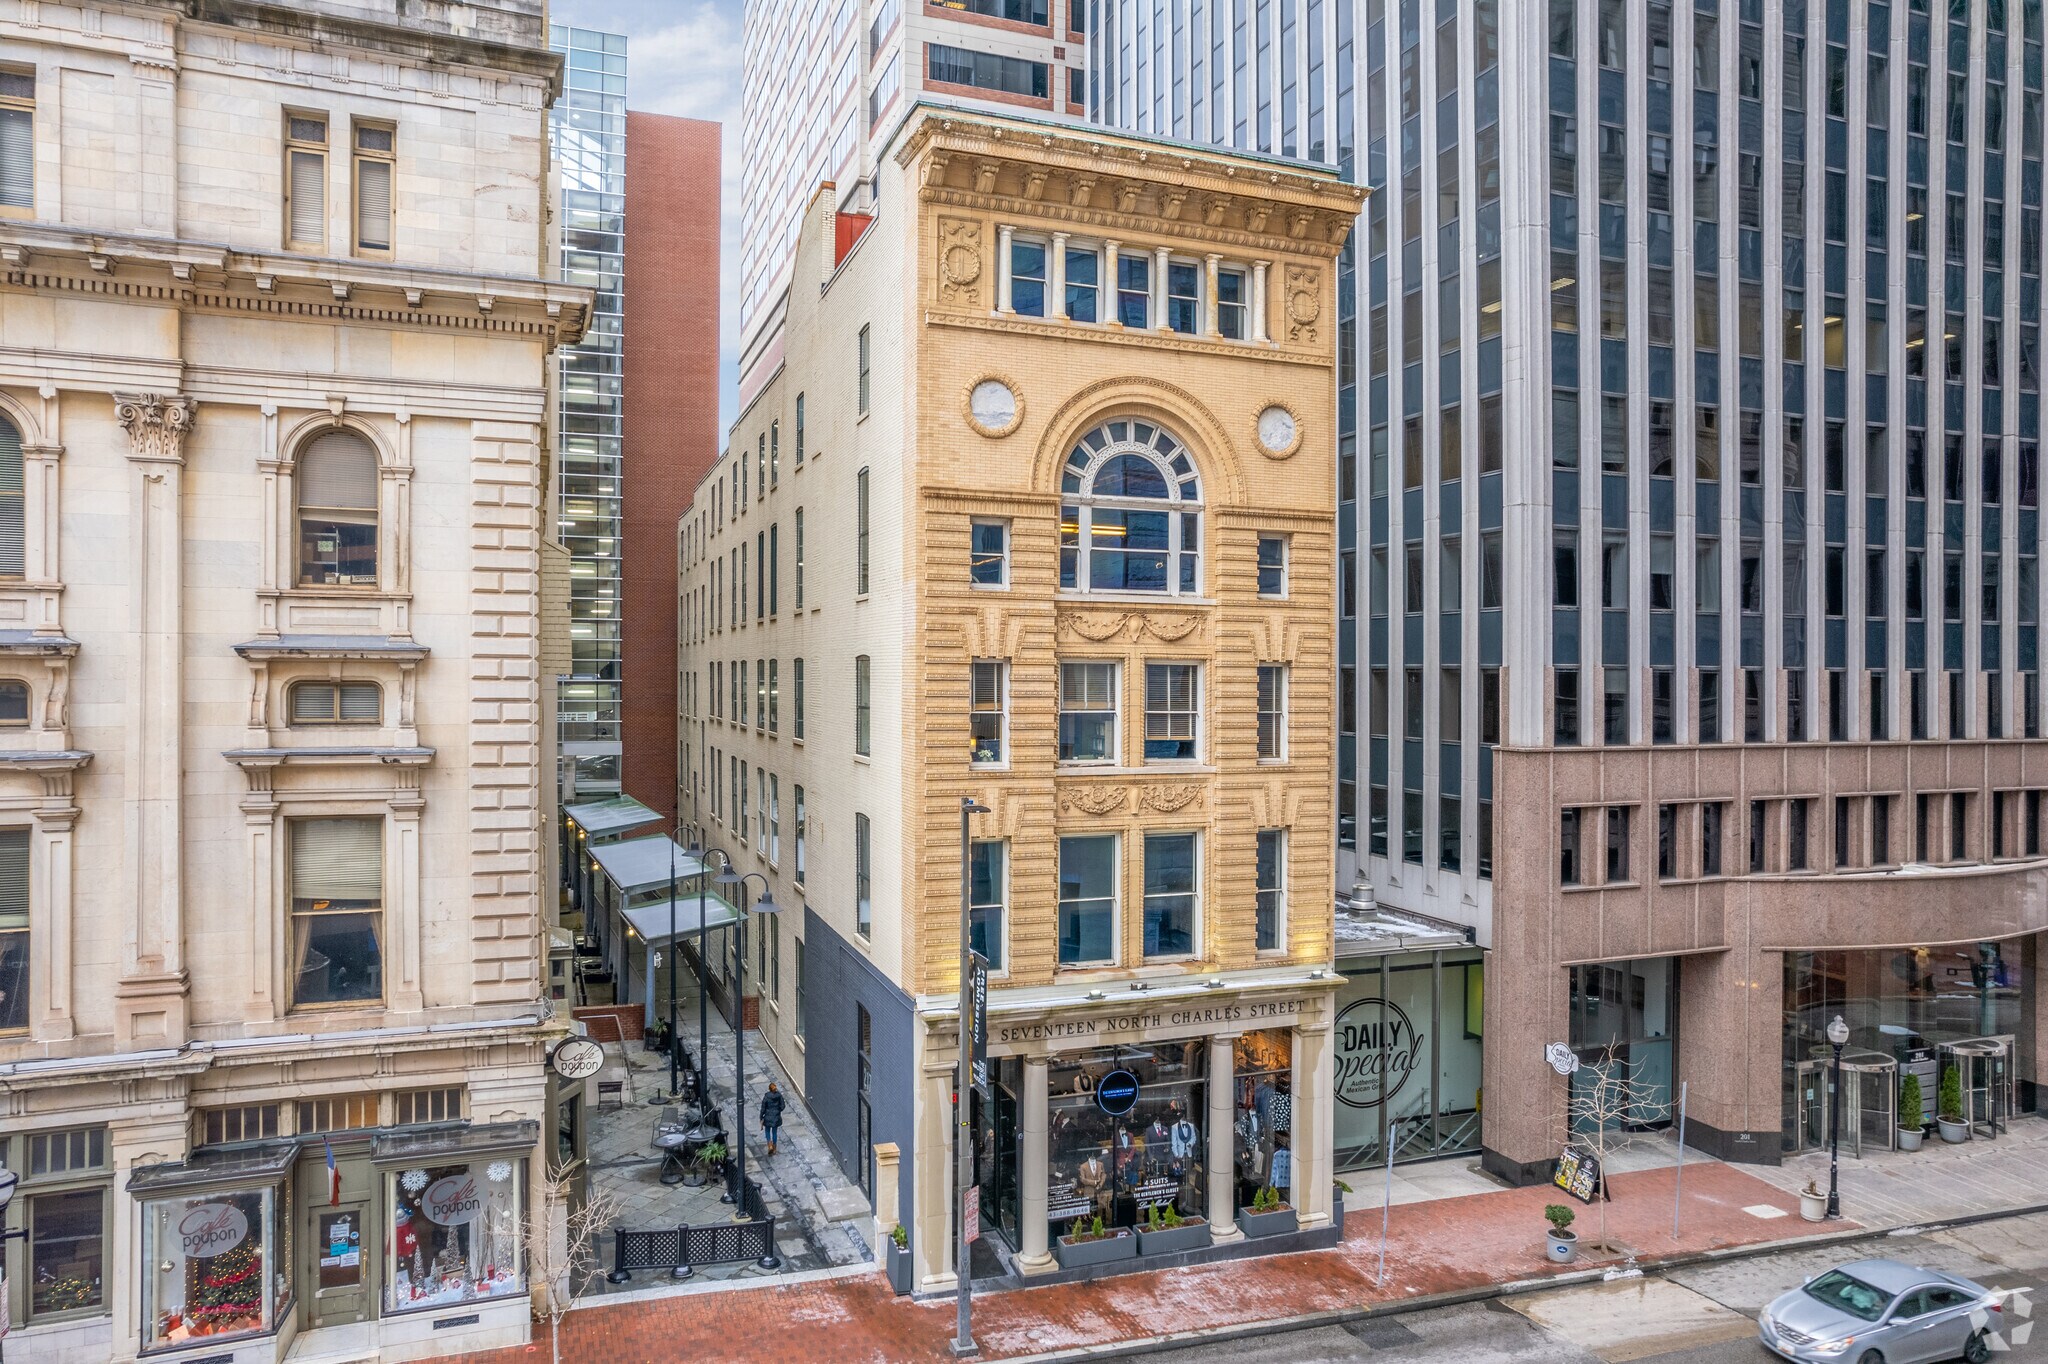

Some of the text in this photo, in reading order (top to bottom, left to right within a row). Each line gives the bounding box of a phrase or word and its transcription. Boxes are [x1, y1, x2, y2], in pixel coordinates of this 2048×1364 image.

[1001, 1021, 1096, 1041] SEVENTEEN
[1107, 1014, 1161, 1031] NORTH
[1171, 1006, 1241, 1025] CHARLES
[1251, 1000, 1305, 1017] STREET
[1344, 1020, 1402, 1052] DAILY
[561, 1061, 599, 1074] poupon
[1346, 1085, 1371, 1094] Mexican
[1351, 1078, 1379, 1087] Authentic
[1150, 1176, 1169, 1186] SUITS
[433, 1199, 480, 1220] poupon
[182, 1228, 237, 1252] poupon
